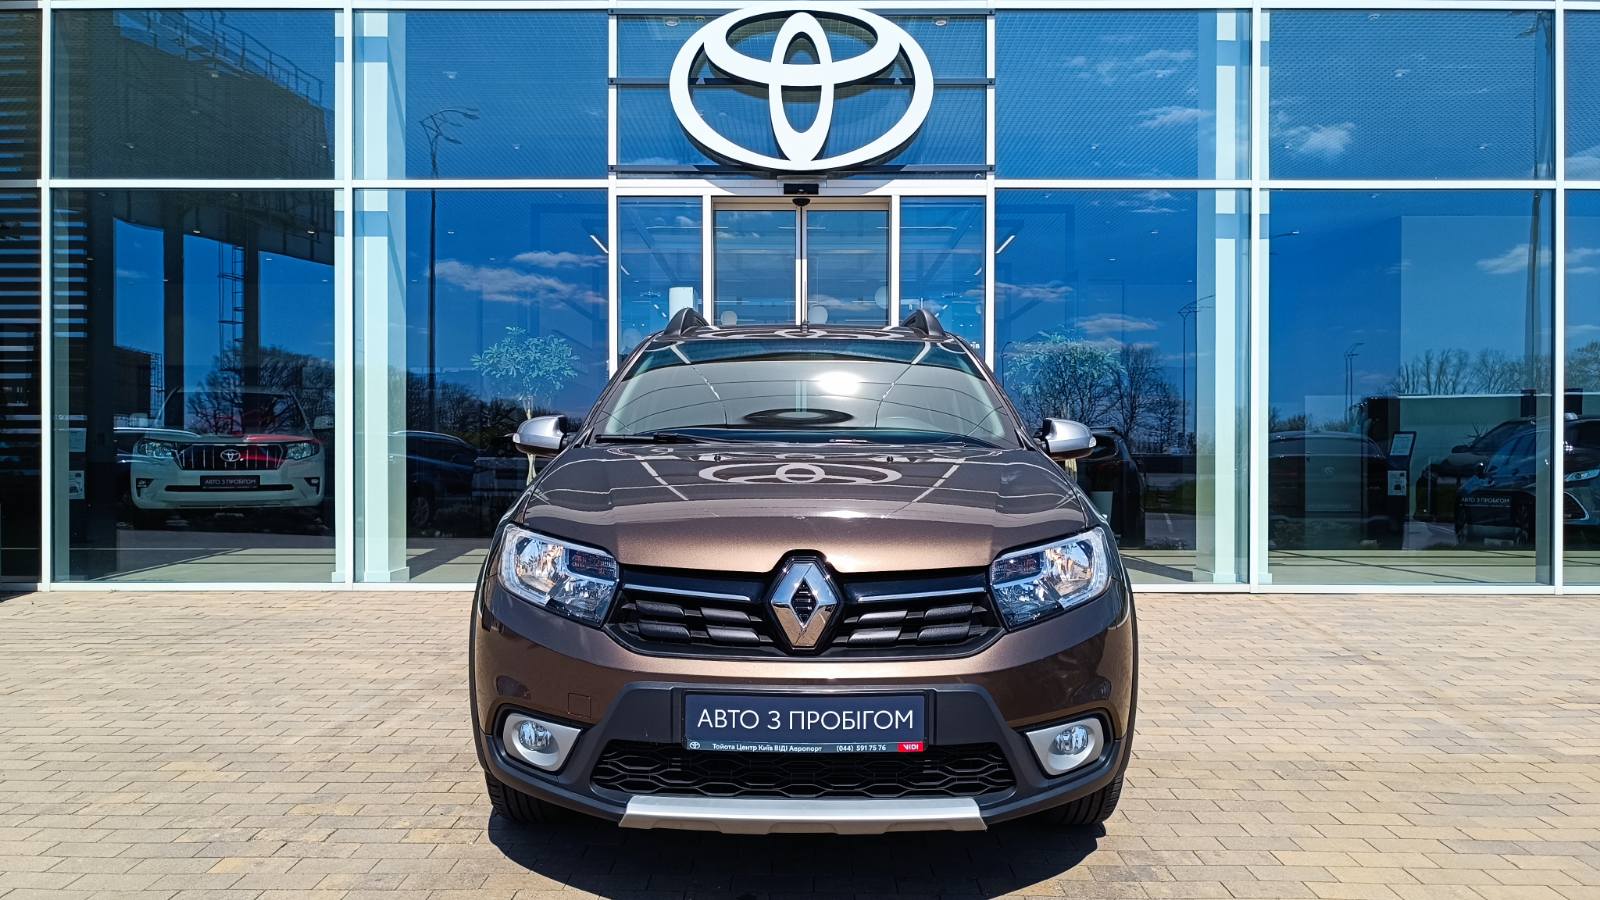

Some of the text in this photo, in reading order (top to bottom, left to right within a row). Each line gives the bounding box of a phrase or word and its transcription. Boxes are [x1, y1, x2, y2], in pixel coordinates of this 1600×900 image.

[697, 709, 759, 729] АВТО
[789, 710, 914, 730] ПРОБІГОМ
[736, 743, 757, 752] Центр
[836, 744, 854, 752] (044)
